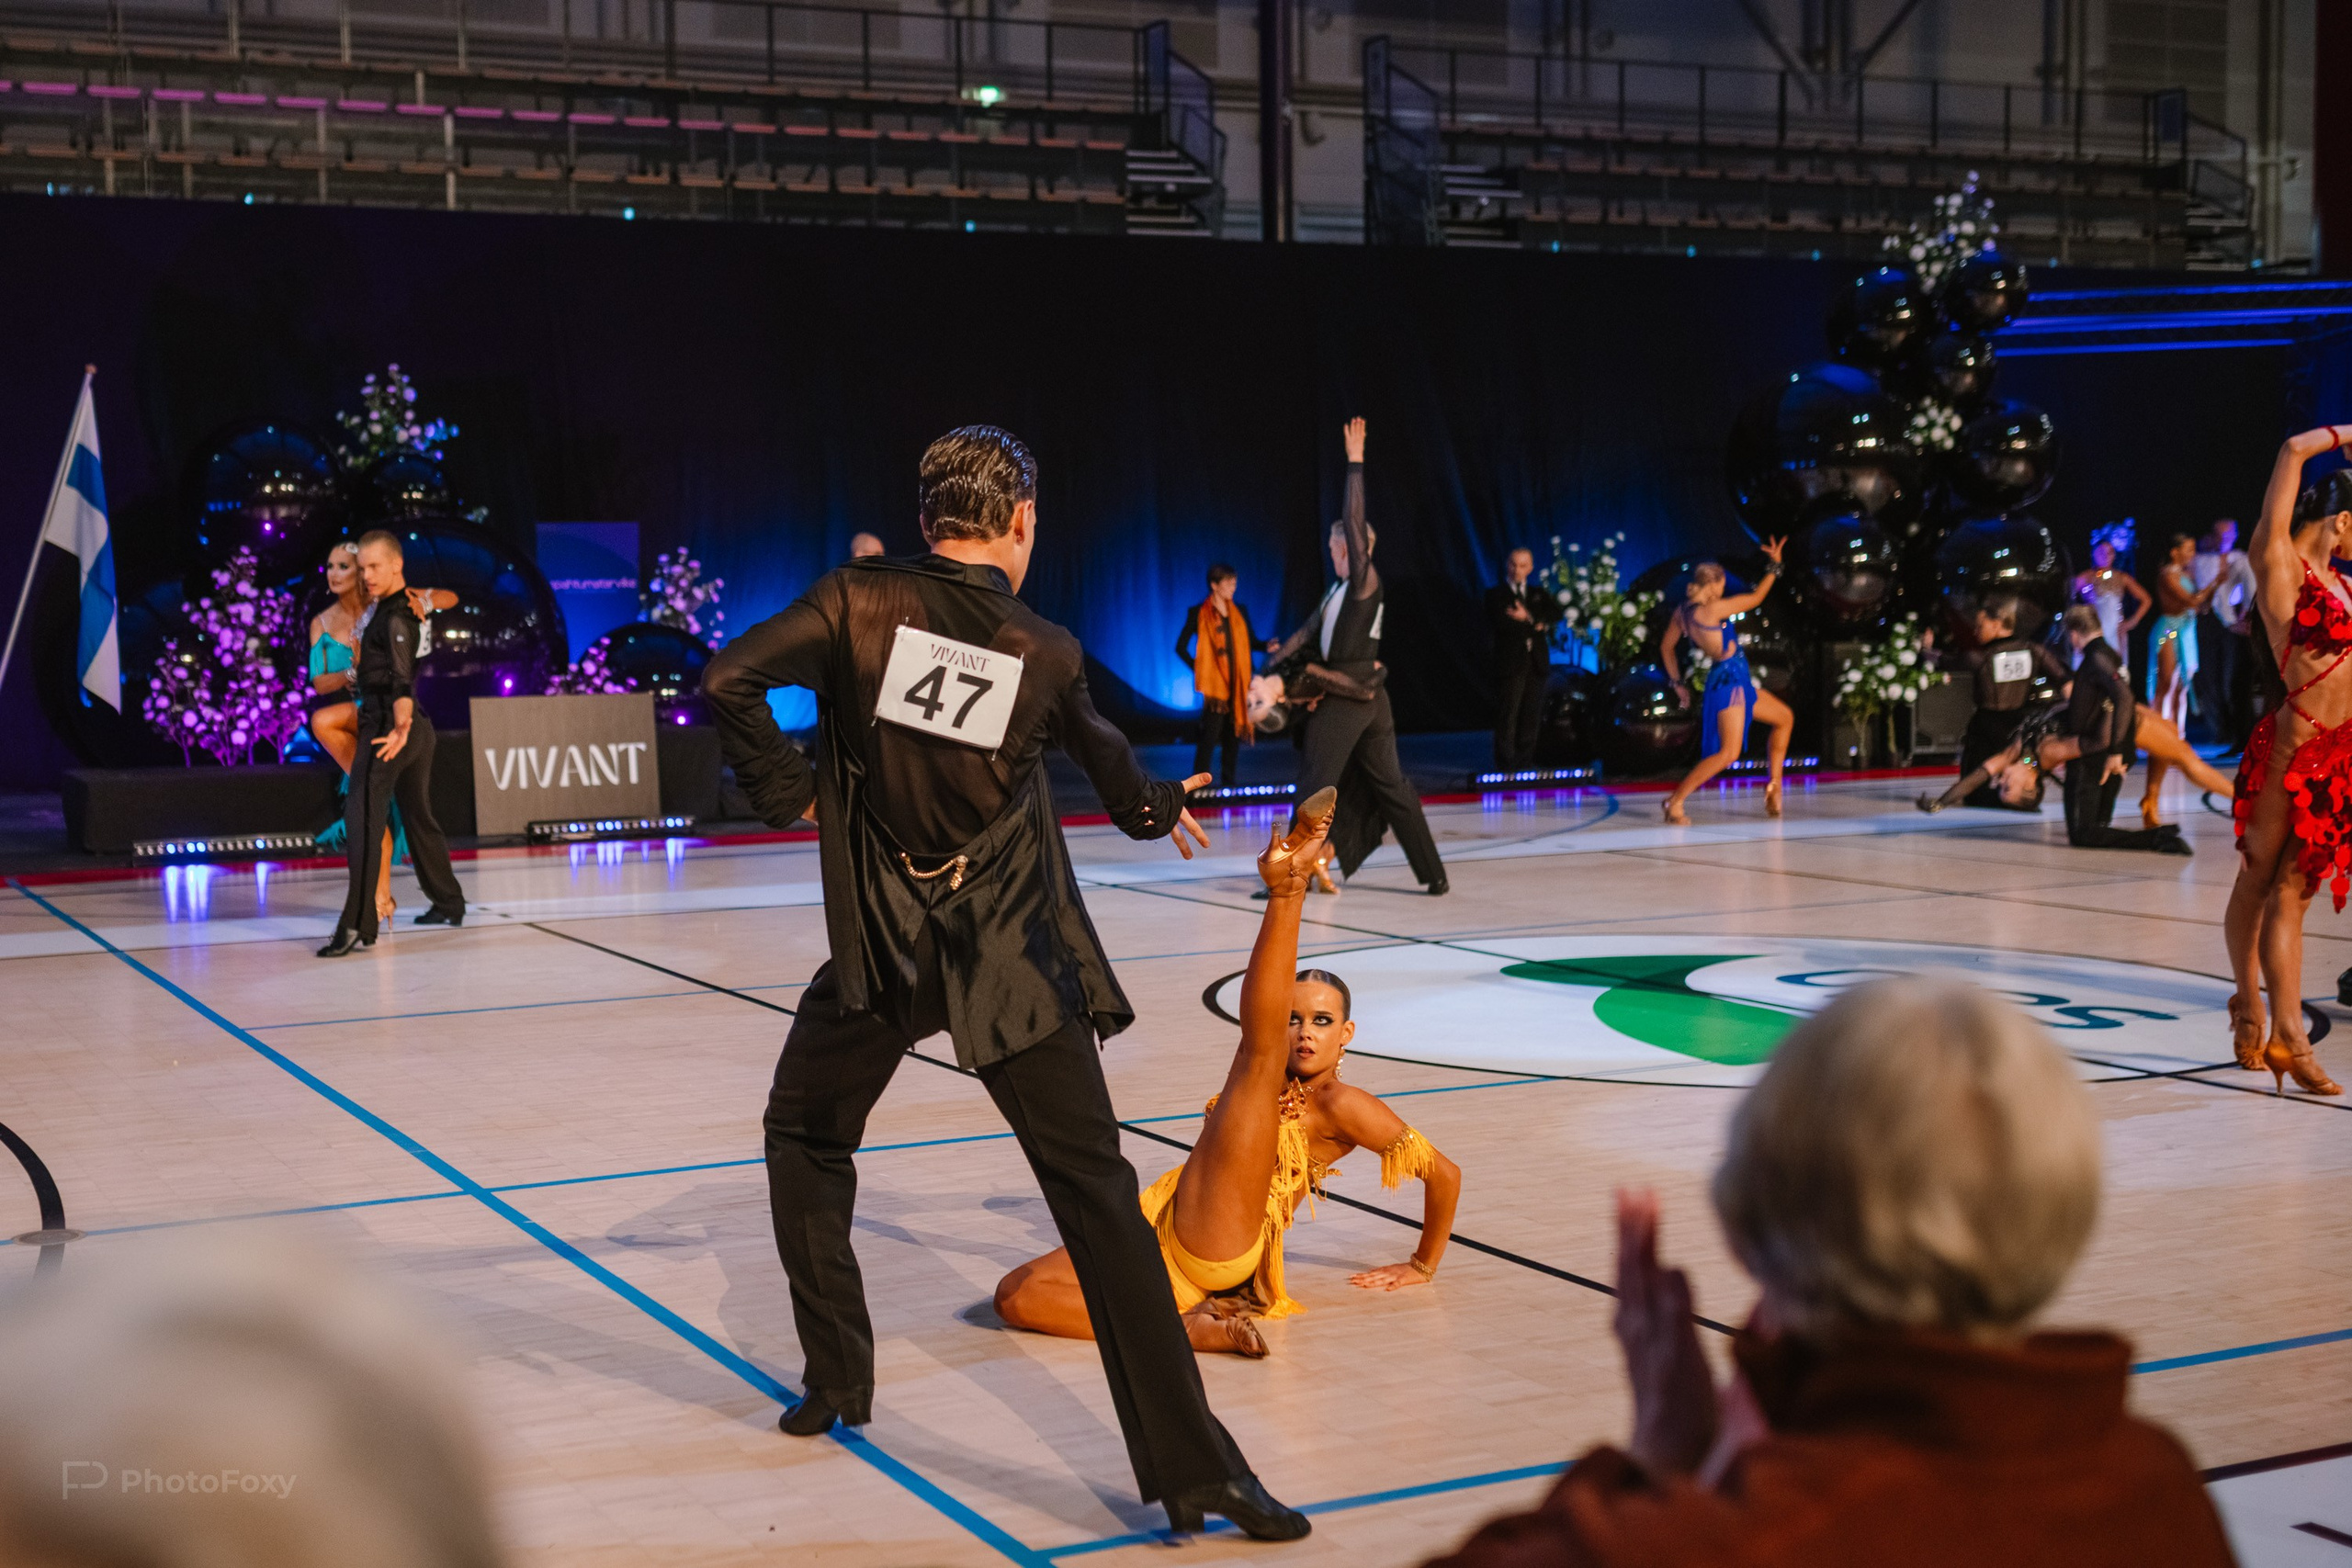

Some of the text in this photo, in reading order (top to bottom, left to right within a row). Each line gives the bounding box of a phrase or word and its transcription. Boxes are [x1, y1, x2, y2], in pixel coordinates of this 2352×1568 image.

[931, 643, 990, 672] VIVANT
[903, 665, 994, 729] 47
[484, 742, 647, 791] VIVANT
